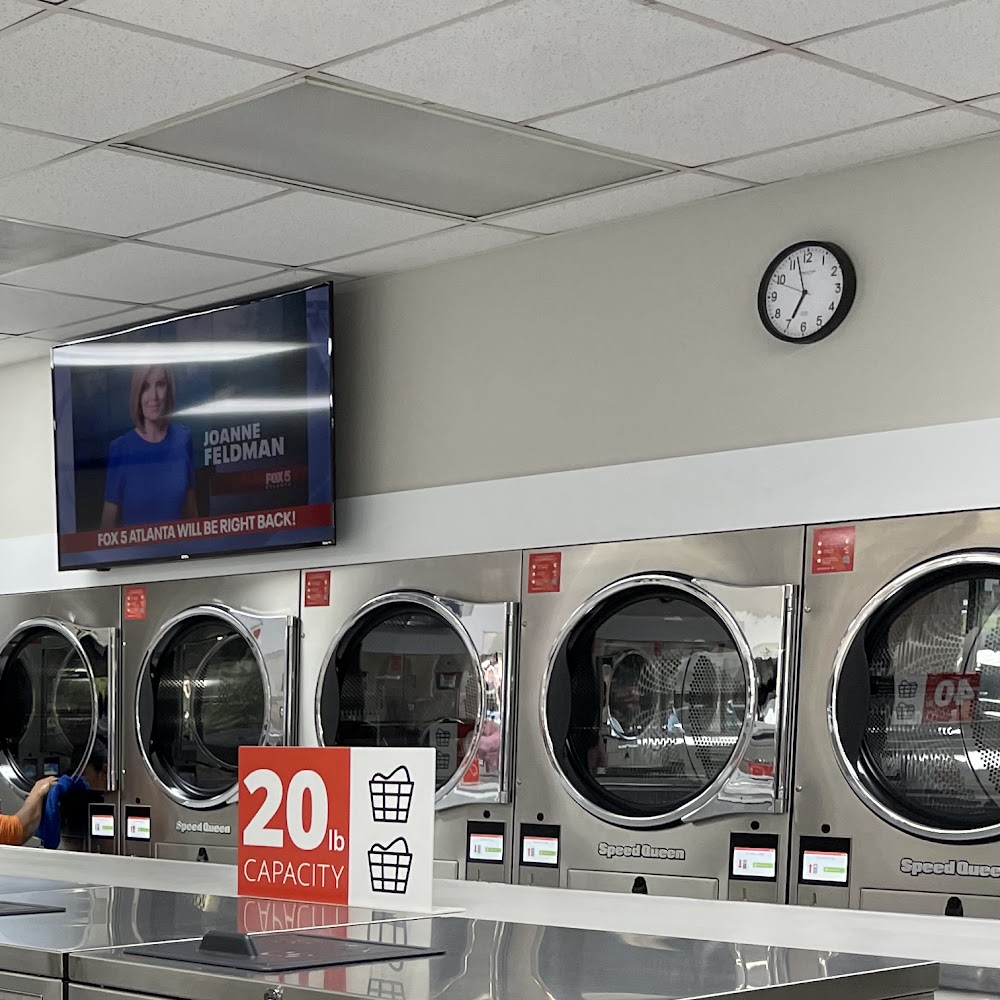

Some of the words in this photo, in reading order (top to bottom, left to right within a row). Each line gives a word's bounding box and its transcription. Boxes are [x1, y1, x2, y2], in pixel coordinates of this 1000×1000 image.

[803, 252, 813, 263] 12
[789, 260, 796, 271] 11
[830, 266, 838, 277] 2
[776, 274, 786, 285] 10
[834, 283, 841, 293] 3
[771, 291, 778, 302] 9
[828, 301, 835, 311] 4
[774, 308, 781, 319] 8
[785, 319, 792, 329] 7
[800, 321, 807, 332] 6
[816, 316, 823, 326] 5
[203, 422, 261, 447] JOANNE
[204, 436, 285, 466] FELDMAN
[265, 471, 283, 485] FOX
[283, 470, 291, 482] 5
[98, 531, 119, 547] FOX
[120, 530, 128, 545] 5
[129, 525, 176, 544] ATLANTA
[177, 522, 202, 539] WILL
[203, 519, 218, 535] BE
[219, 516, 255, 534] RIGHT
[257, 510, 296, 530] BACK!
[598, 842, 641, 859] Speed
[642, 844, 686, 861] Queen
[243, 858, 345, 889] CAPACITY
[900, 858, 956, 876] Speed
[956, 859, 1000, 878] Quee
